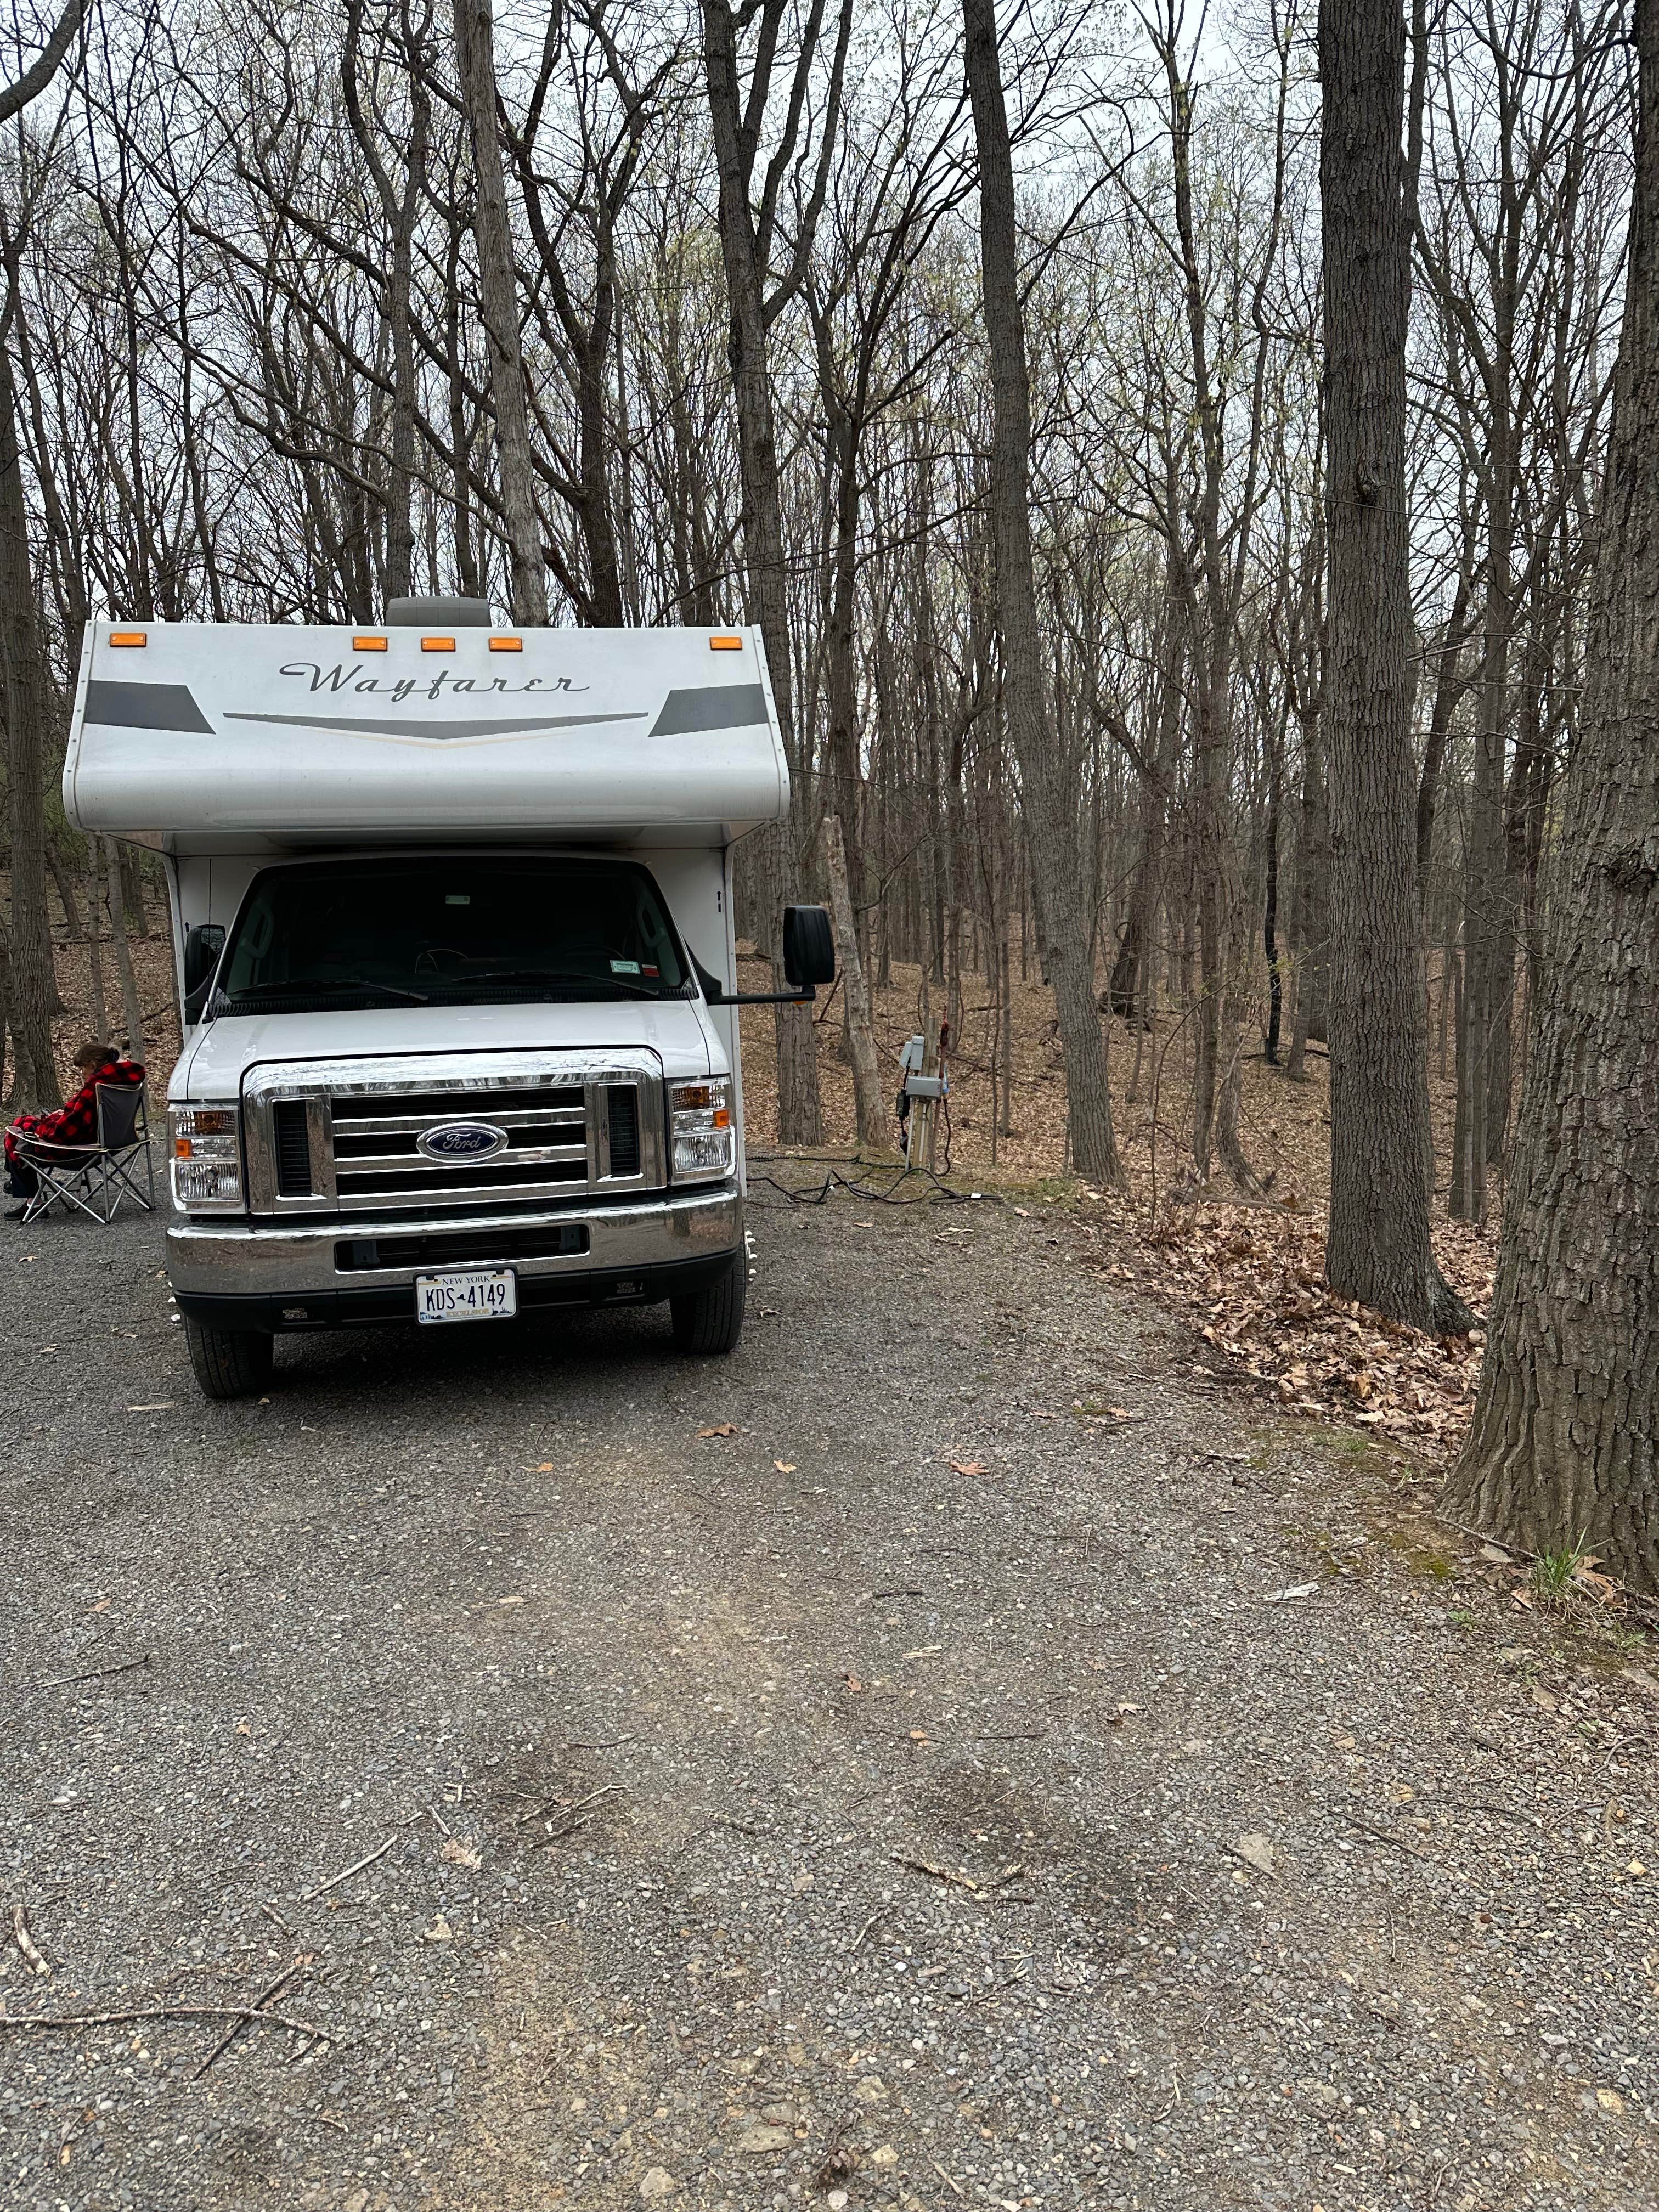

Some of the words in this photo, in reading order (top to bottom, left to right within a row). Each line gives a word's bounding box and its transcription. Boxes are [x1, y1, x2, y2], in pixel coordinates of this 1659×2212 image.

[279, 663, 590, 702] Wayfarer
[443, 1133, 481, 1150] Ford
[442, 1277, 464, 1285] NEW
[466, 1275, 490, 1283] YORK
